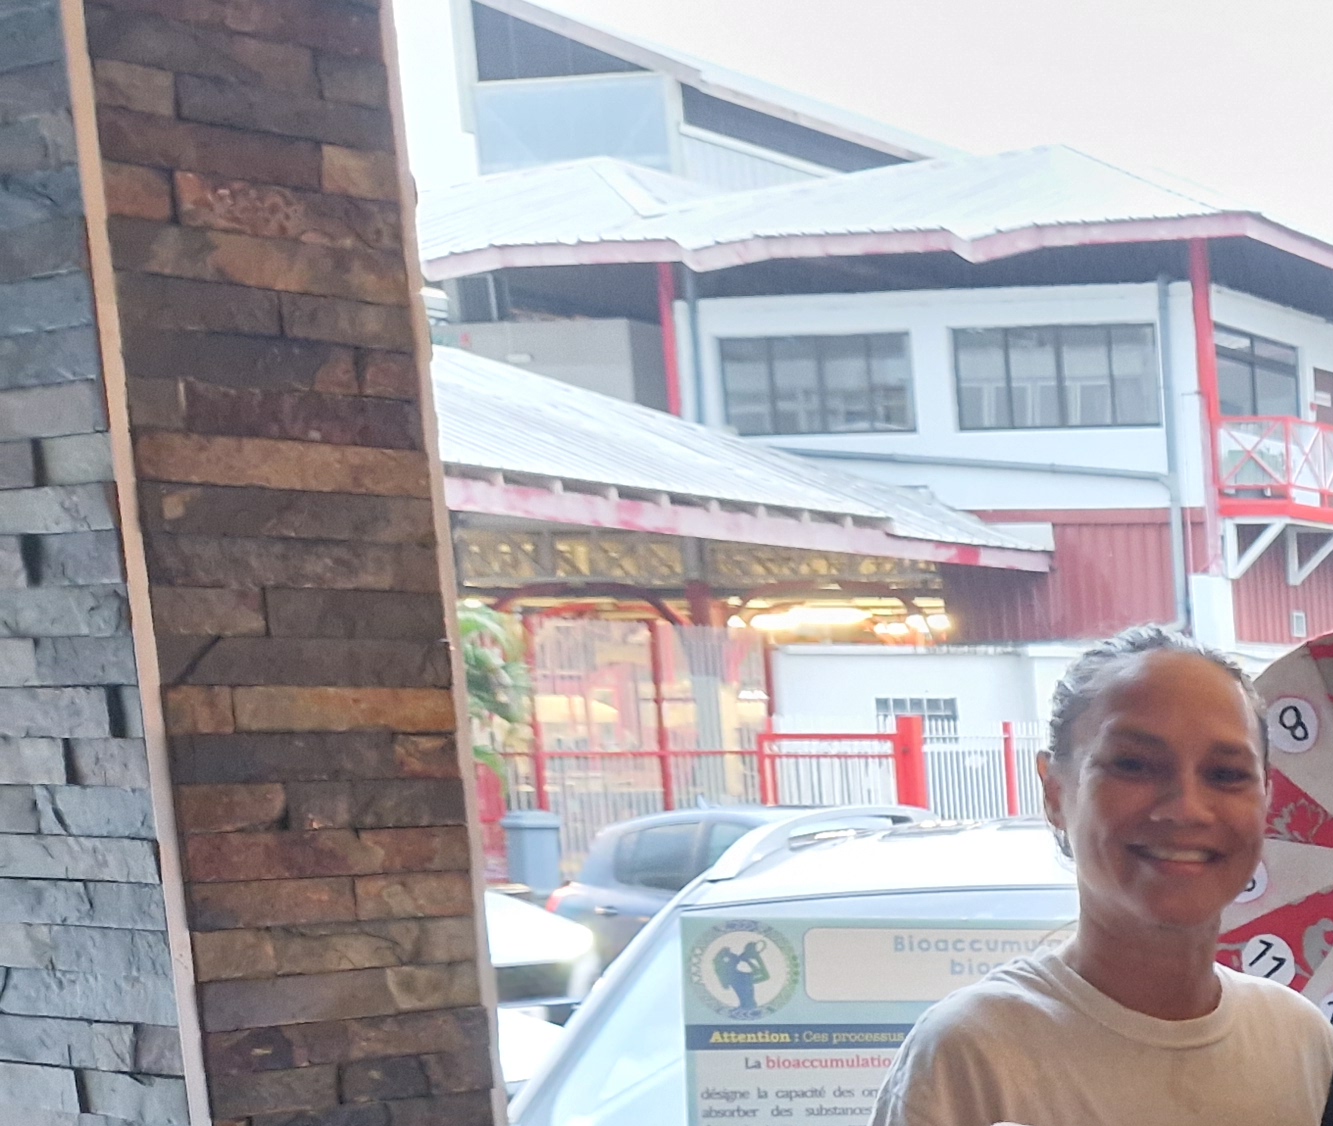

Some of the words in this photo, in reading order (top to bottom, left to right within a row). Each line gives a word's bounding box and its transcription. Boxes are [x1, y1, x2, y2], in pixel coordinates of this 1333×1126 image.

[1279, 706, 1309, 742] 8
[709, 1030, 791, 1044] Attention
[803, 1031, 829, 1043] Ces
[832, 1032, 905, 1045] processus
[744, 1057, 762, 1070] La
[701, 1087, 750, 1102] désigne
[757, 1088, 768, 1099] la
[775, 1086, 826, 1102] capacité
[833, 1086, 855, 1099] des
[702, 1105, 760, 1119] absorber
[771, 1104, 794, 1117] des
